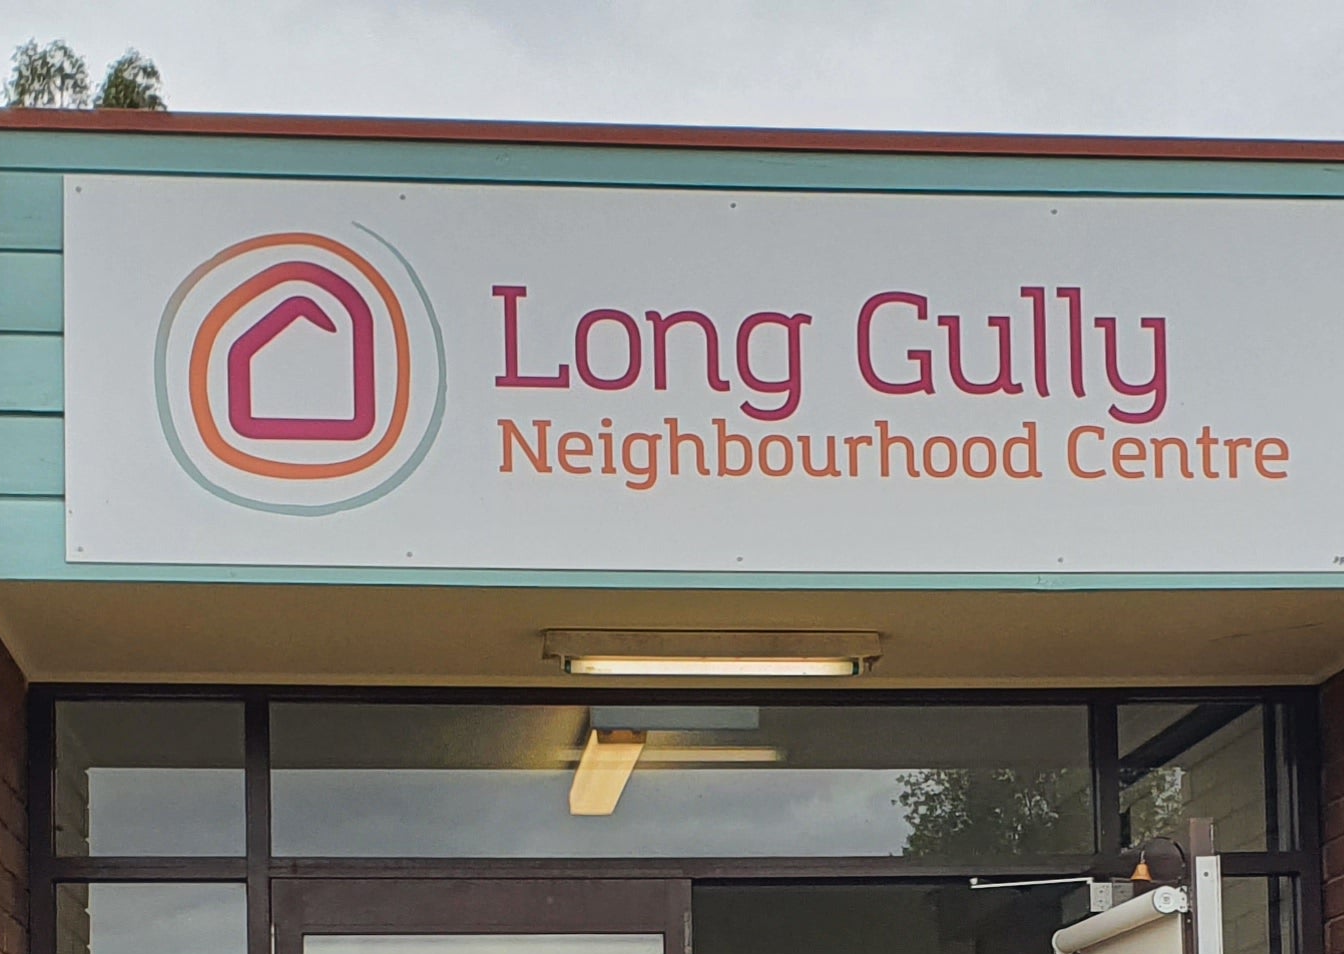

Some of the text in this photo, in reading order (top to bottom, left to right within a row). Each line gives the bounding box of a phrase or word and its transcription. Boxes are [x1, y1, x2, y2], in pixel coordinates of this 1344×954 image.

[492, 285, 1167, 424] Long Gully
[498, 417, 1289, 489] Neighbourhood Centre
